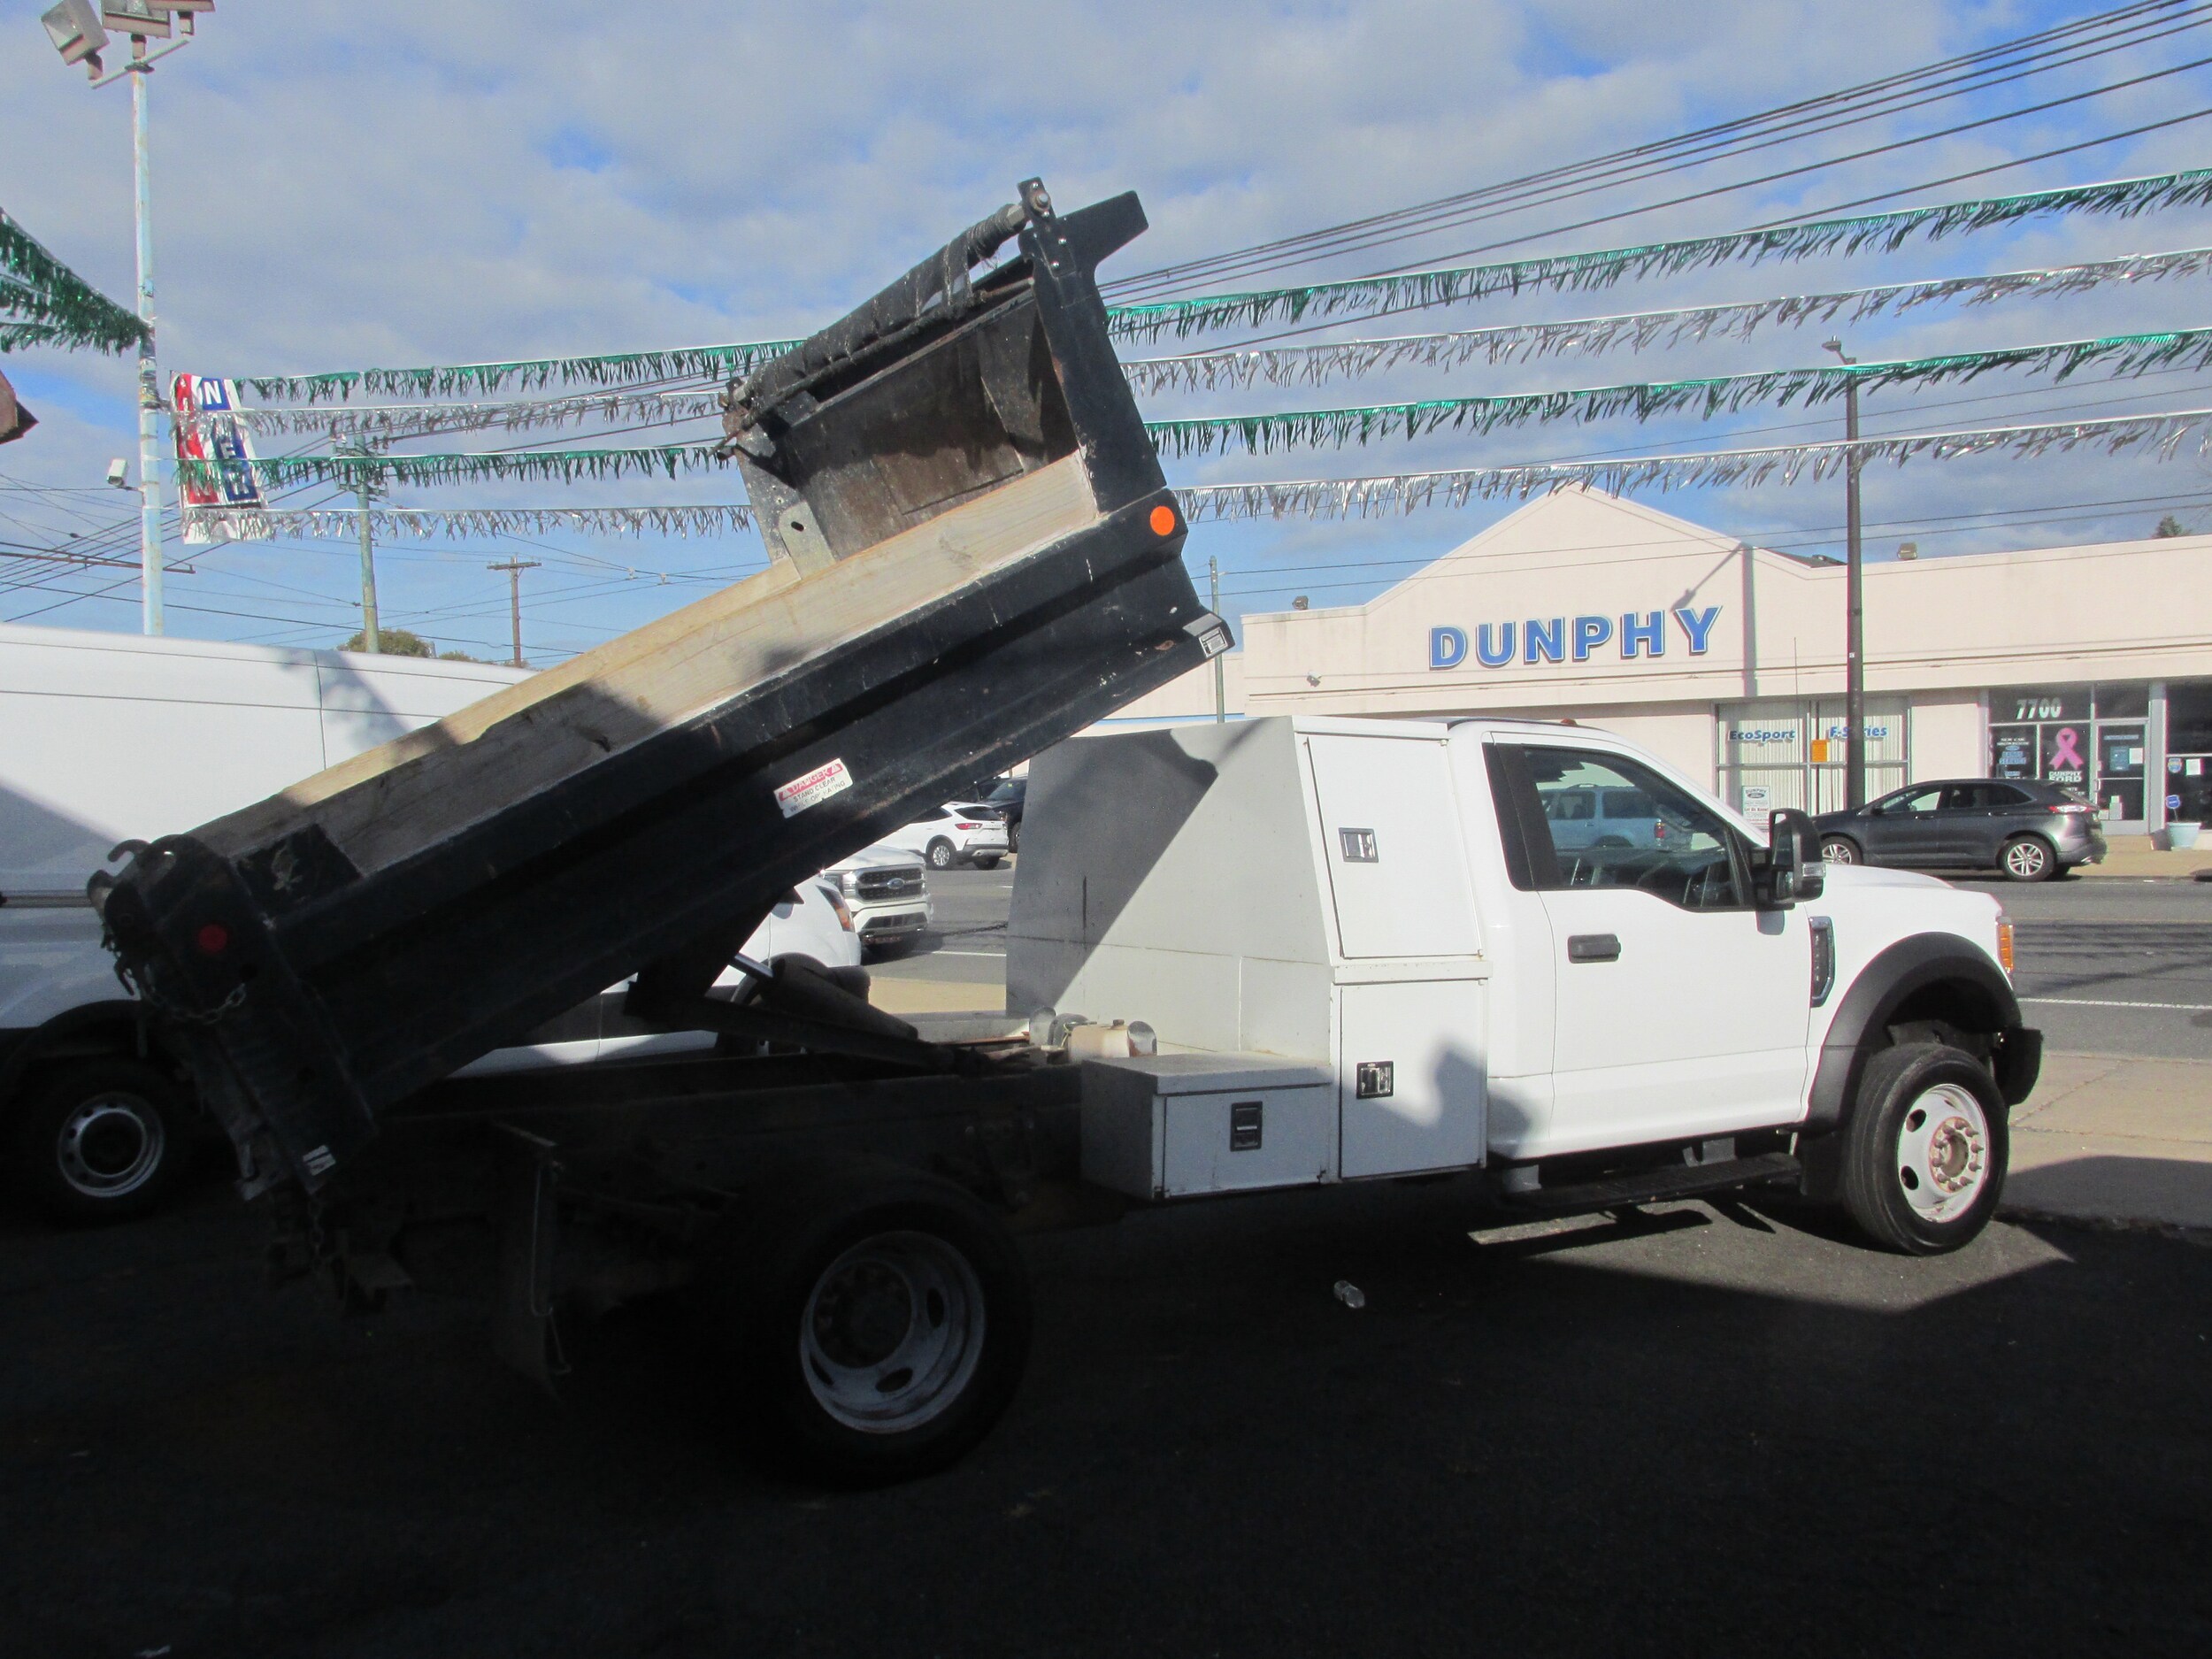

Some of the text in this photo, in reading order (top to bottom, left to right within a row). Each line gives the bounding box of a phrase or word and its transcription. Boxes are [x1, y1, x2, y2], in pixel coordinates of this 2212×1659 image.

[1428, 605, 1723, 670] DUNPHY
[2016, 697, 2062, 719] 7700
[1729, 729, 1796, 741] EcoSport
[1830, 725, 1887, 738] F-Sies
[793, 777, 835, 803] STAND CLEAR
